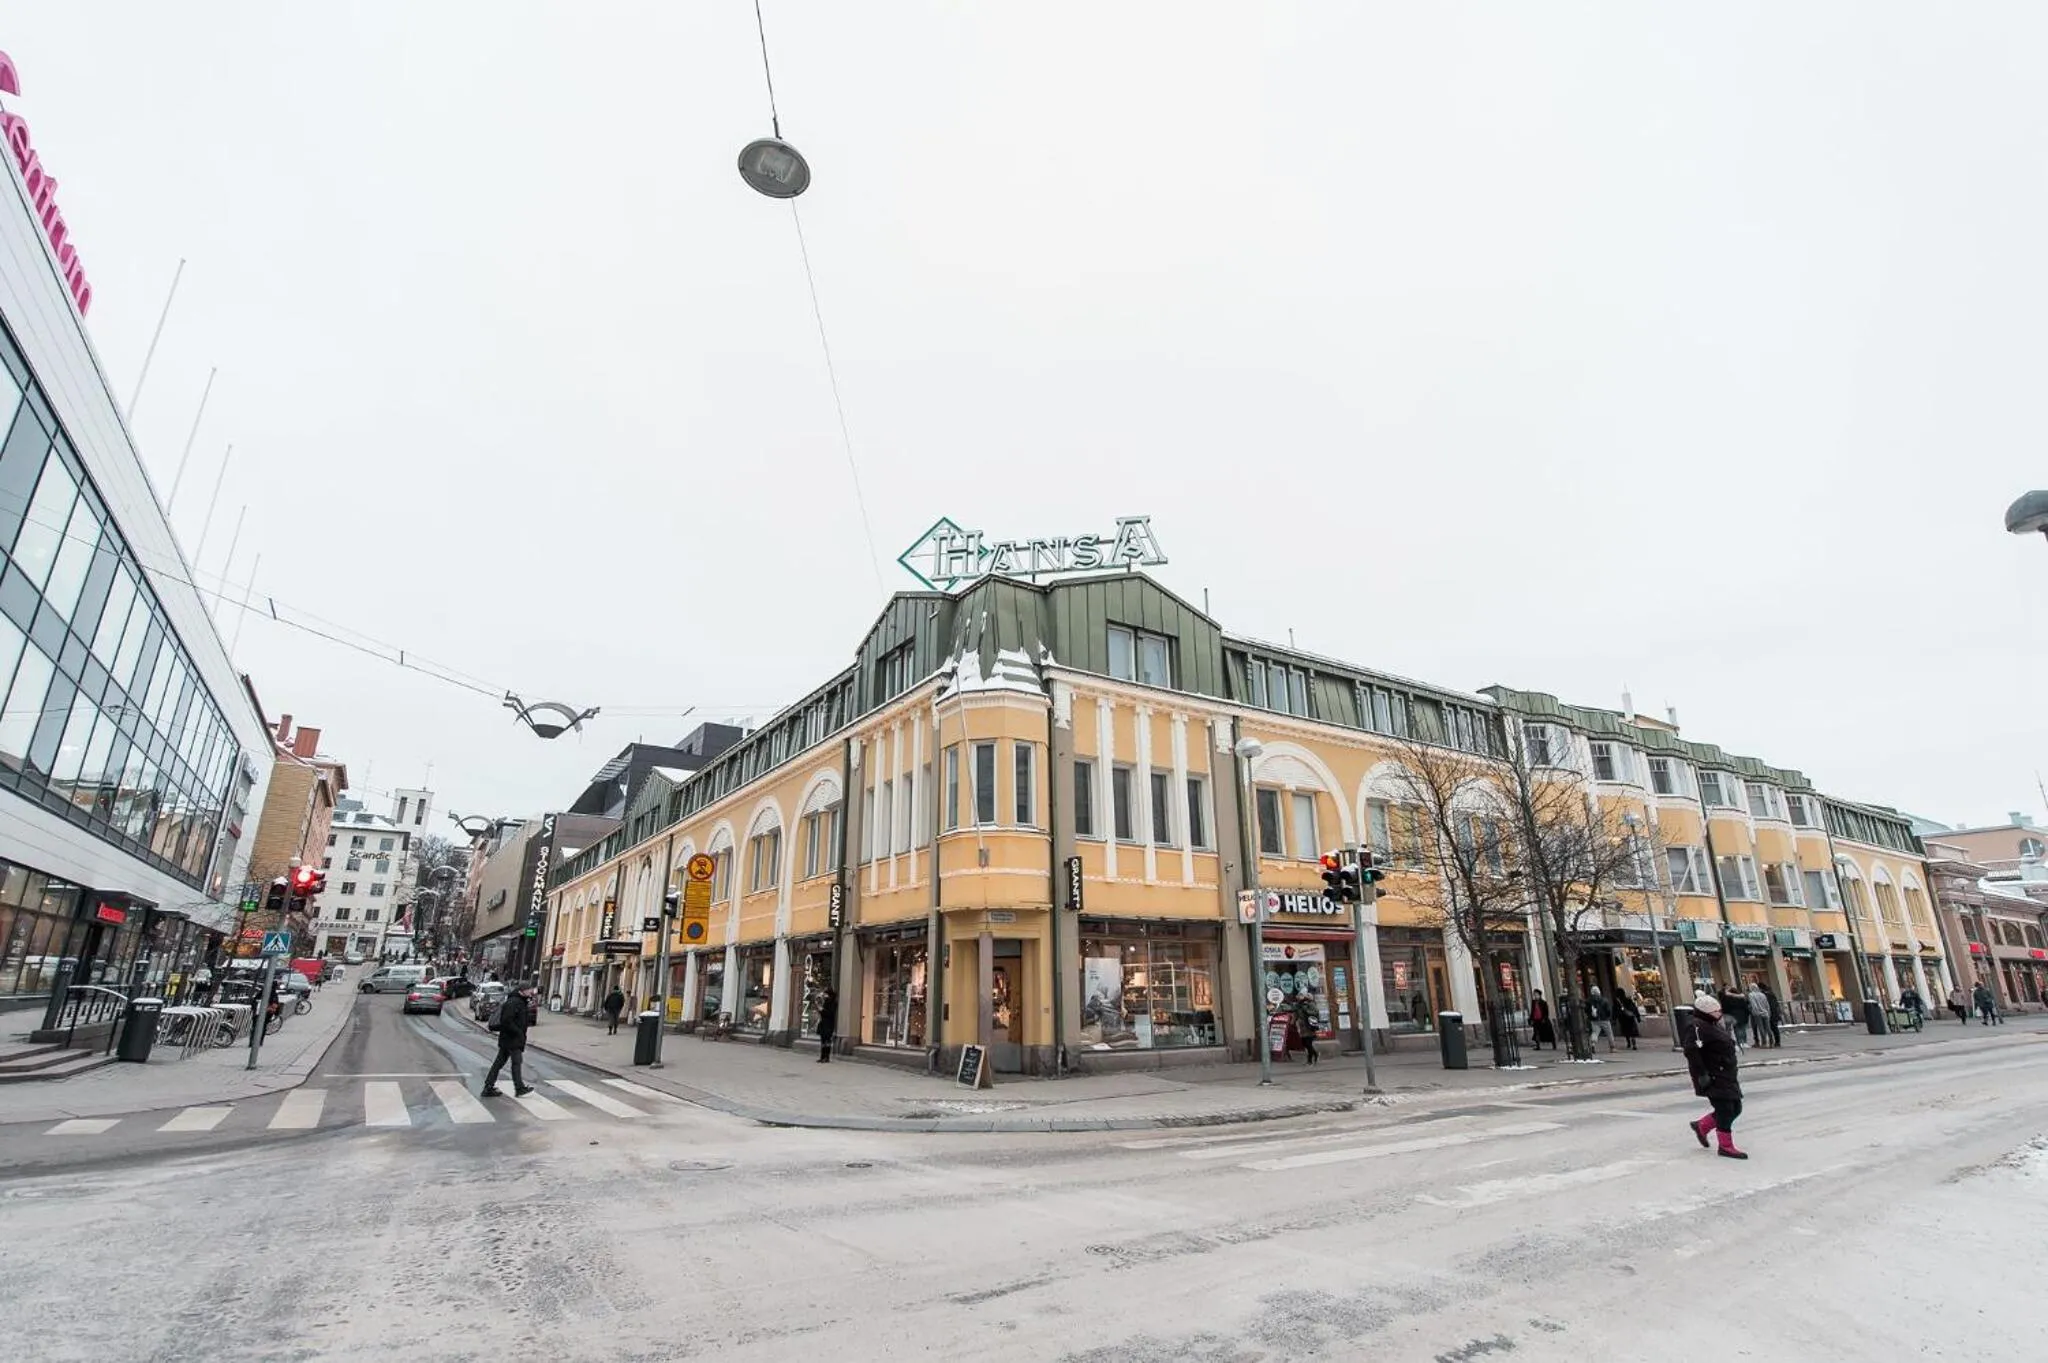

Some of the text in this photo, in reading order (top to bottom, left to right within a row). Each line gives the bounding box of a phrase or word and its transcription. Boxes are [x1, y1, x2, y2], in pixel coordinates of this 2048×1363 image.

[931, 515, 1168, 582] HANSA
[350, 849, 391, 861] Scandic
[531, 846, 550, 911] STOCKMANN
